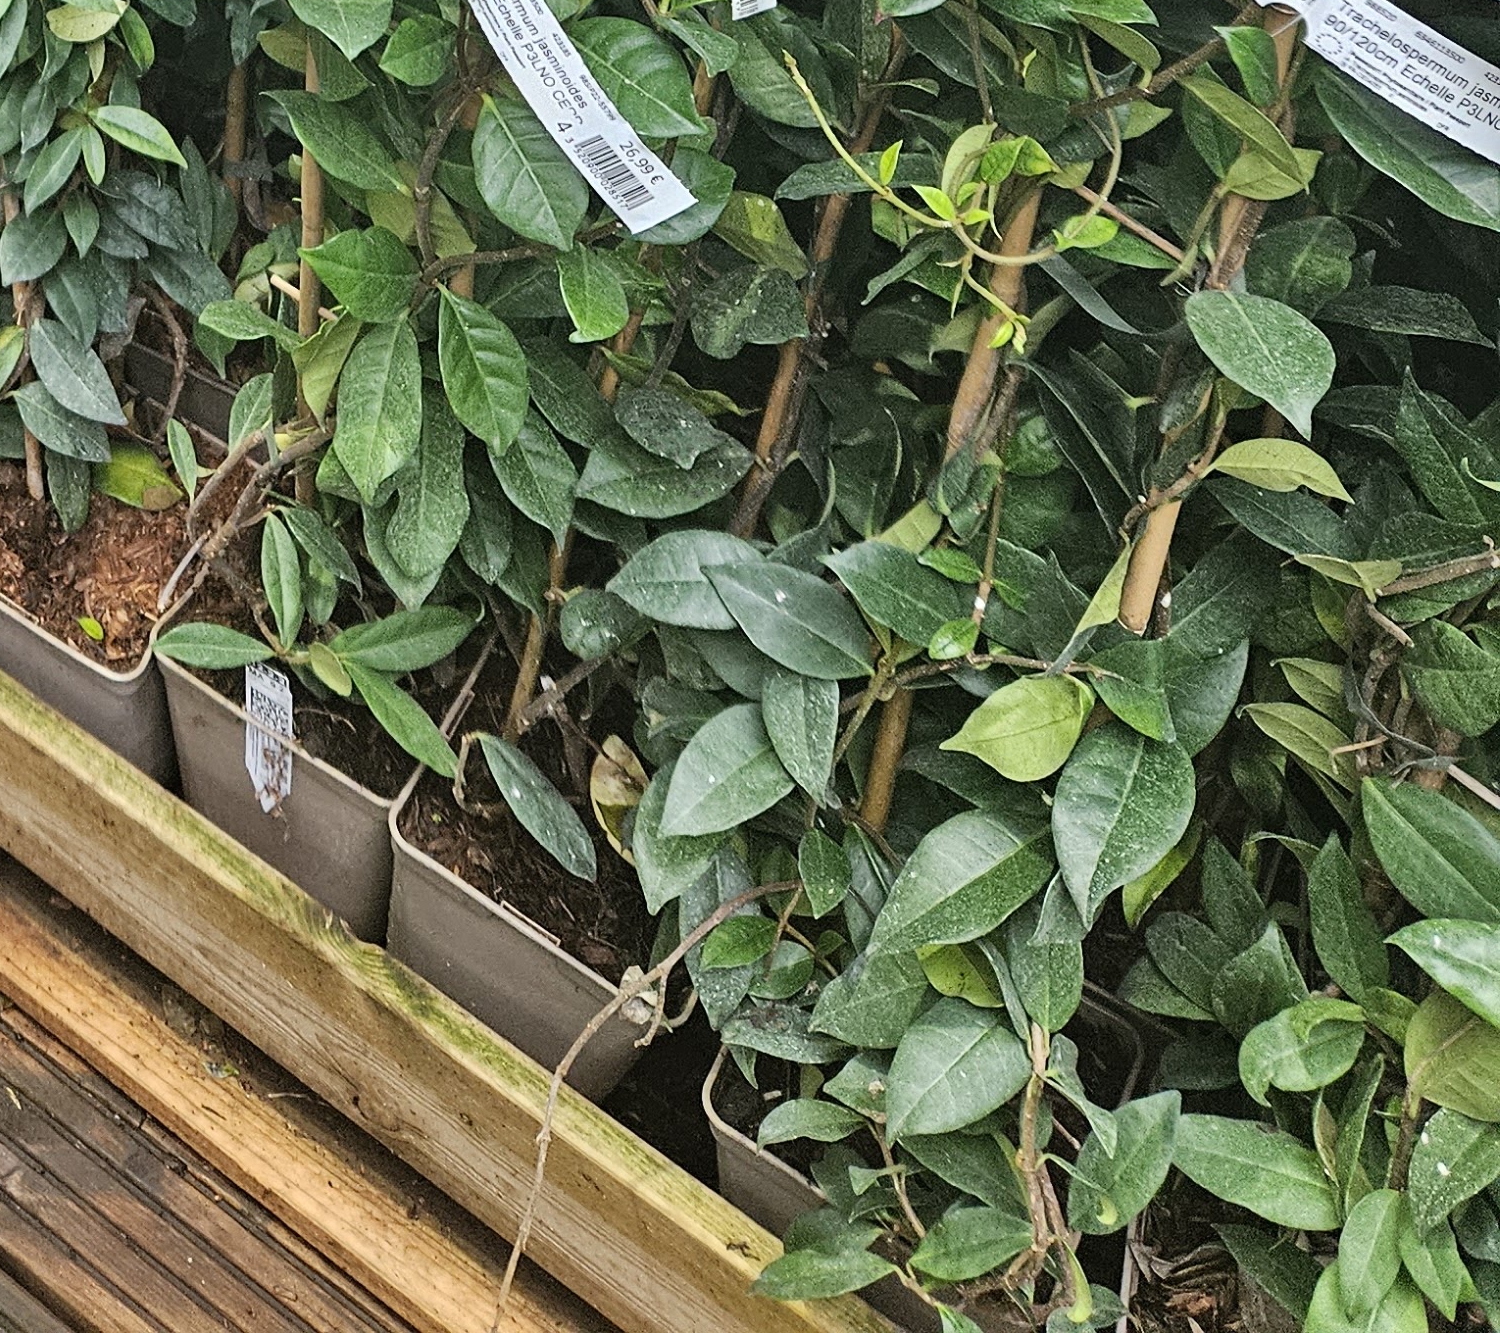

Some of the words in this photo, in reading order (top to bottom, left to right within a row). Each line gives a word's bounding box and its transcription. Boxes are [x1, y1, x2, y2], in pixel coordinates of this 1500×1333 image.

[521, 42, 556, 88] P3LNO
[537, 35, 587, 110] jasminoides
[1324, 13, 1399, 69] 90/120cm
[1400, 64, 1456, 104] Echelle
[557, 121, 572, 133] 4
[619, 140, 654, 174] 26,99
